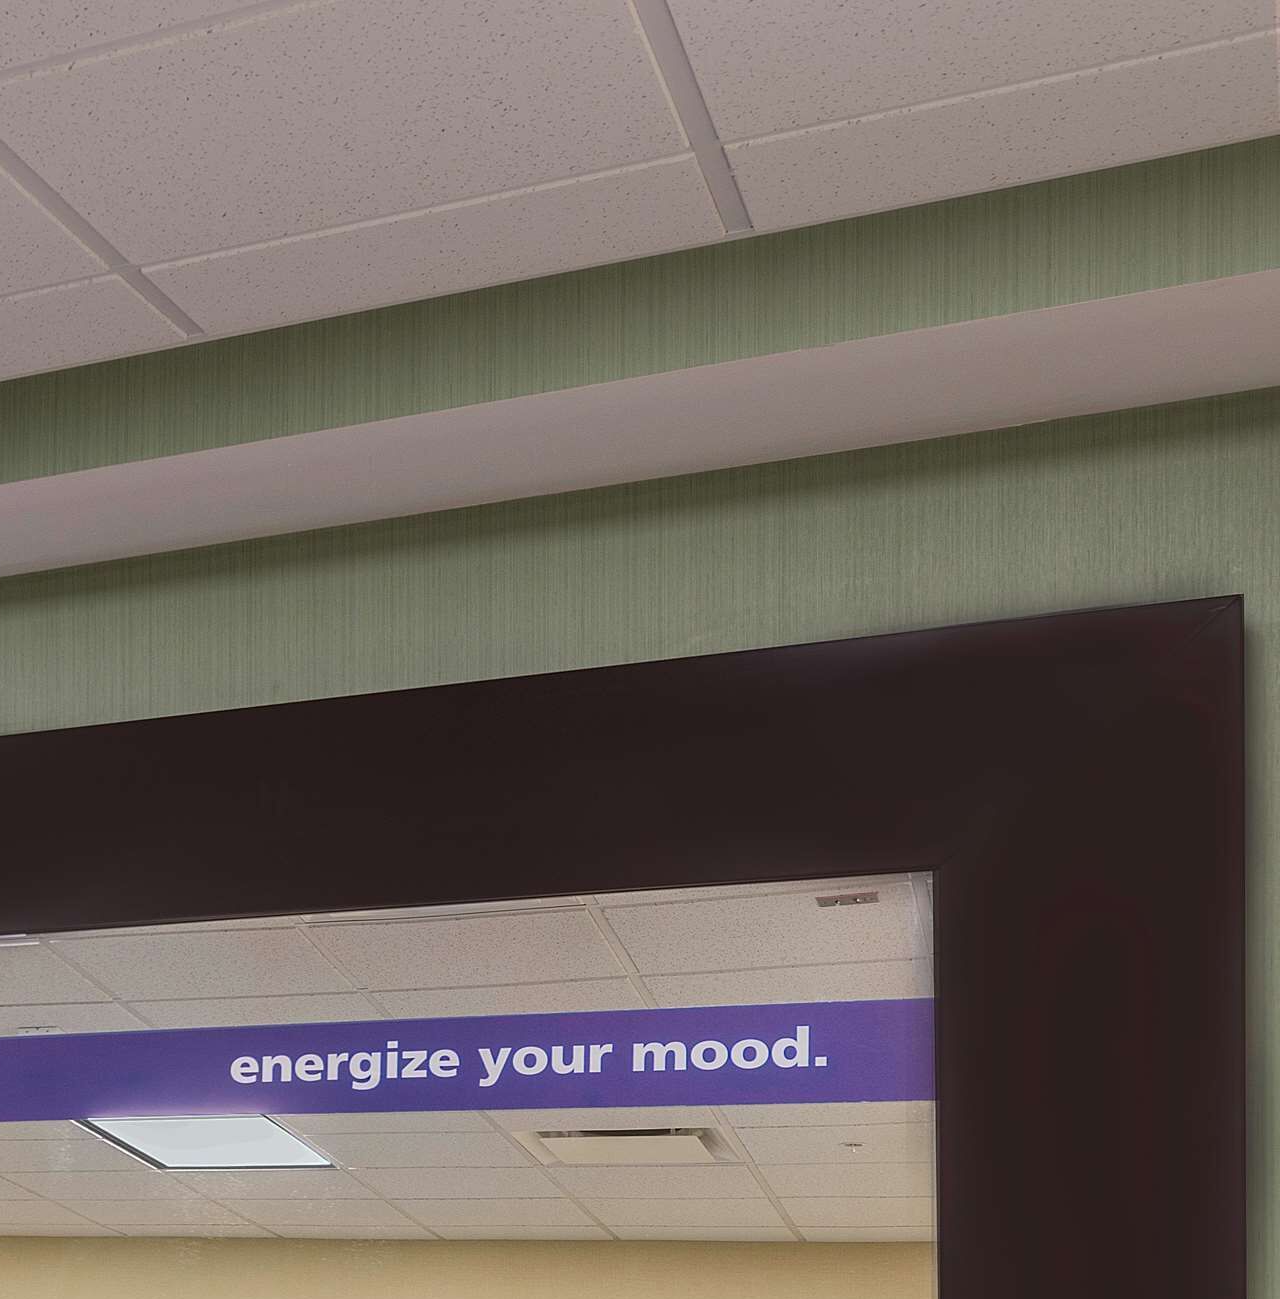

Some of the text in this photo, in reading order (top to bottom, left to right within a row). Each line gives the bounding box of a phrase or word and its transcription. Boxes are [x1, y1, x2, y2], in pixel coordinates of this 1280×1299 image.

[230, 1025, 828, 1091] energize your mood.
